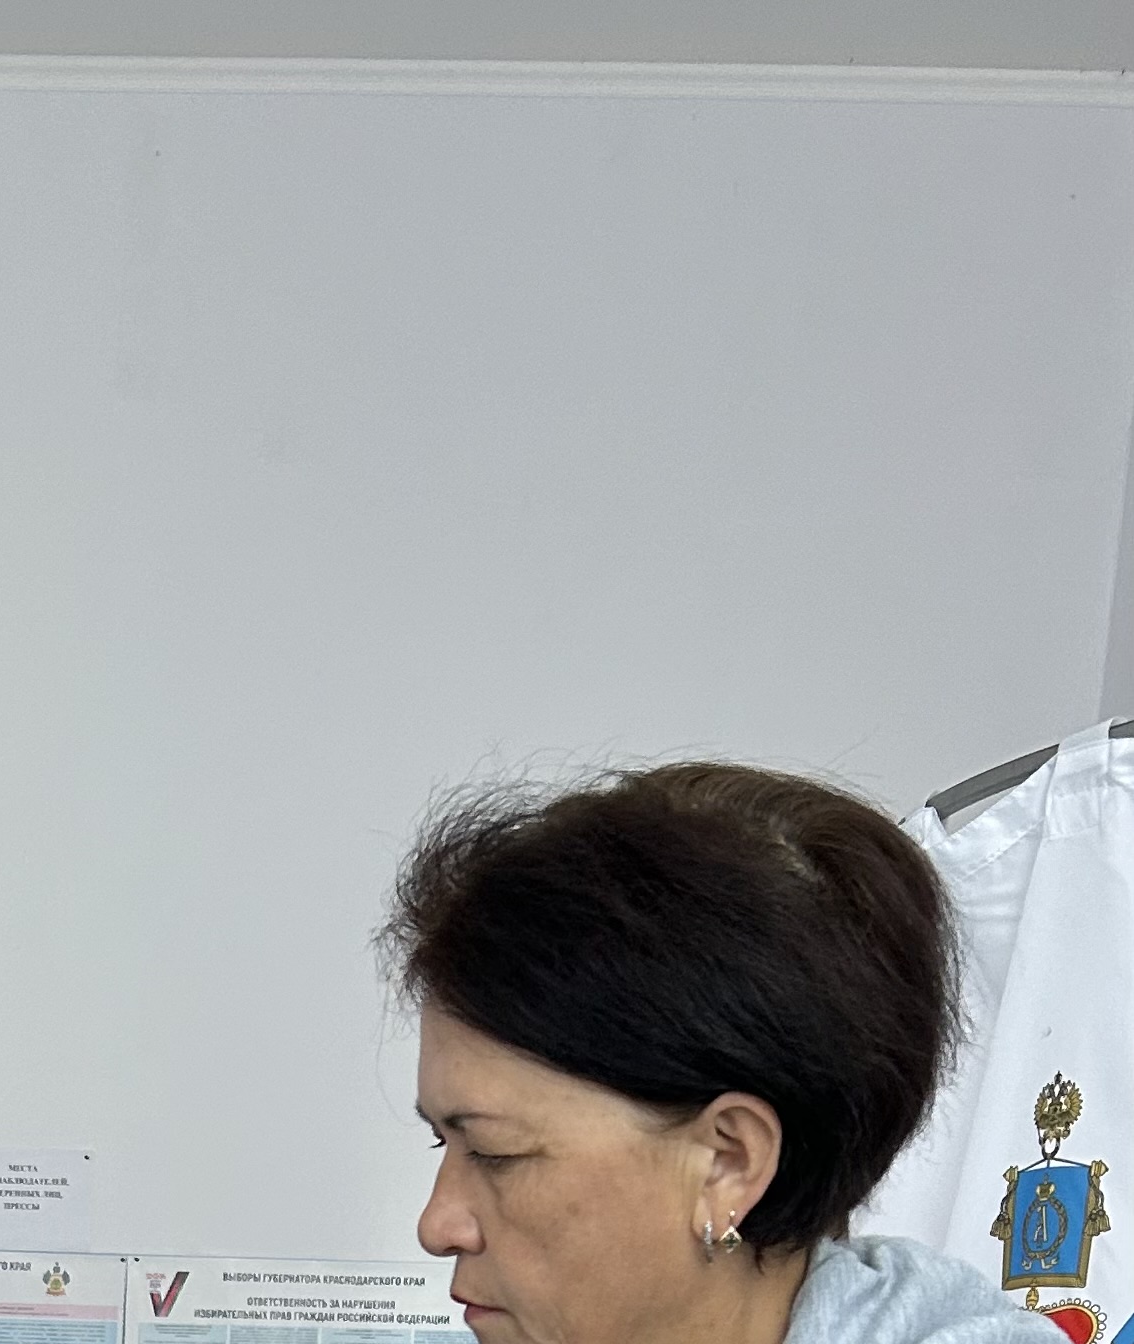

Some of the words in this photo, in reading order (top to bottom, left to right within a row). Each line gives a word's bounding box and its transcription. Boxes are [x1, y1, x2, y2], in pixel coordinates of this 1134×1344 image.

[8, 1164, 38, 1172] МЕСТА
[3, 1202, 40, 1210] ПРЕССЫ
[9, 1262, 32, 1271] КРАЯ
[222, 1272, 262, 1282] ВЫБОРЫ
[263, 1273, 321, 1284] ГУБЕРНАТОРА
[323, 1275, 402, 1286] КРАСНОДАРСКОГО
[404, 1277, 426, 1286] КРАЯ
[247, 1297, 328, 1308] ОТВЕТСТВЕННОСТЬ
[329, 1300, 340, 1308] ЗА
[342, 1300, 396, 1310] НАРУШЕНИЯ
[194, 1309, 267, 1320] ИЗБИРАТЕЛЬНЫХ
[269, 1311, 292, 1321] ПРАВ
[294, 1312, 335, 1322] ГРАЖДАН
[337, 1312, 395, 1324] РОССИЙСКОЙ
[396, 1313, 451, 1325] ФЕДЕРАЦИИ
